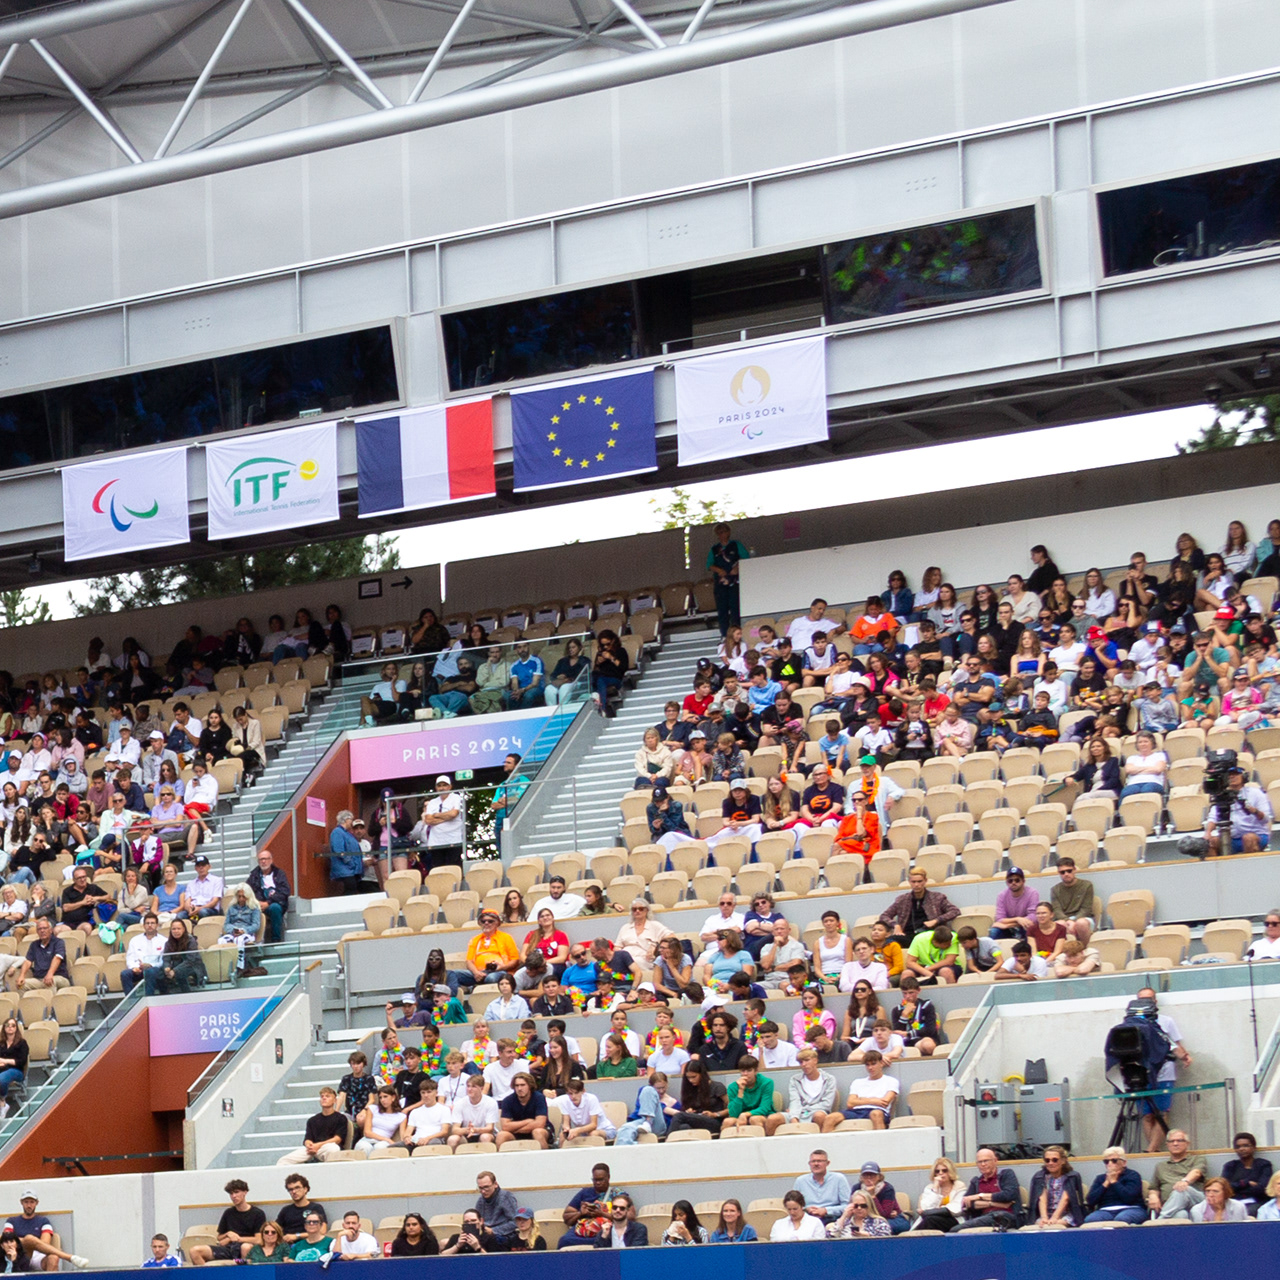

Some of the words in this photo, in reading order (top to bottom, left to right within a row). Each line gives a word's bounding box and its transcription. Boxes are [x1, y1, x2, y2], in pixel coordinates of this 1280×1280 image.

[755, 406, 784, 418] 2024
[234, 470, 290, 507] ITF
[233, 506, 269, 517] International
[271, 502, 289, 512] Tennis
[290, 498, 320, 508] Federation
[468, 736, 522, 754] 2024
